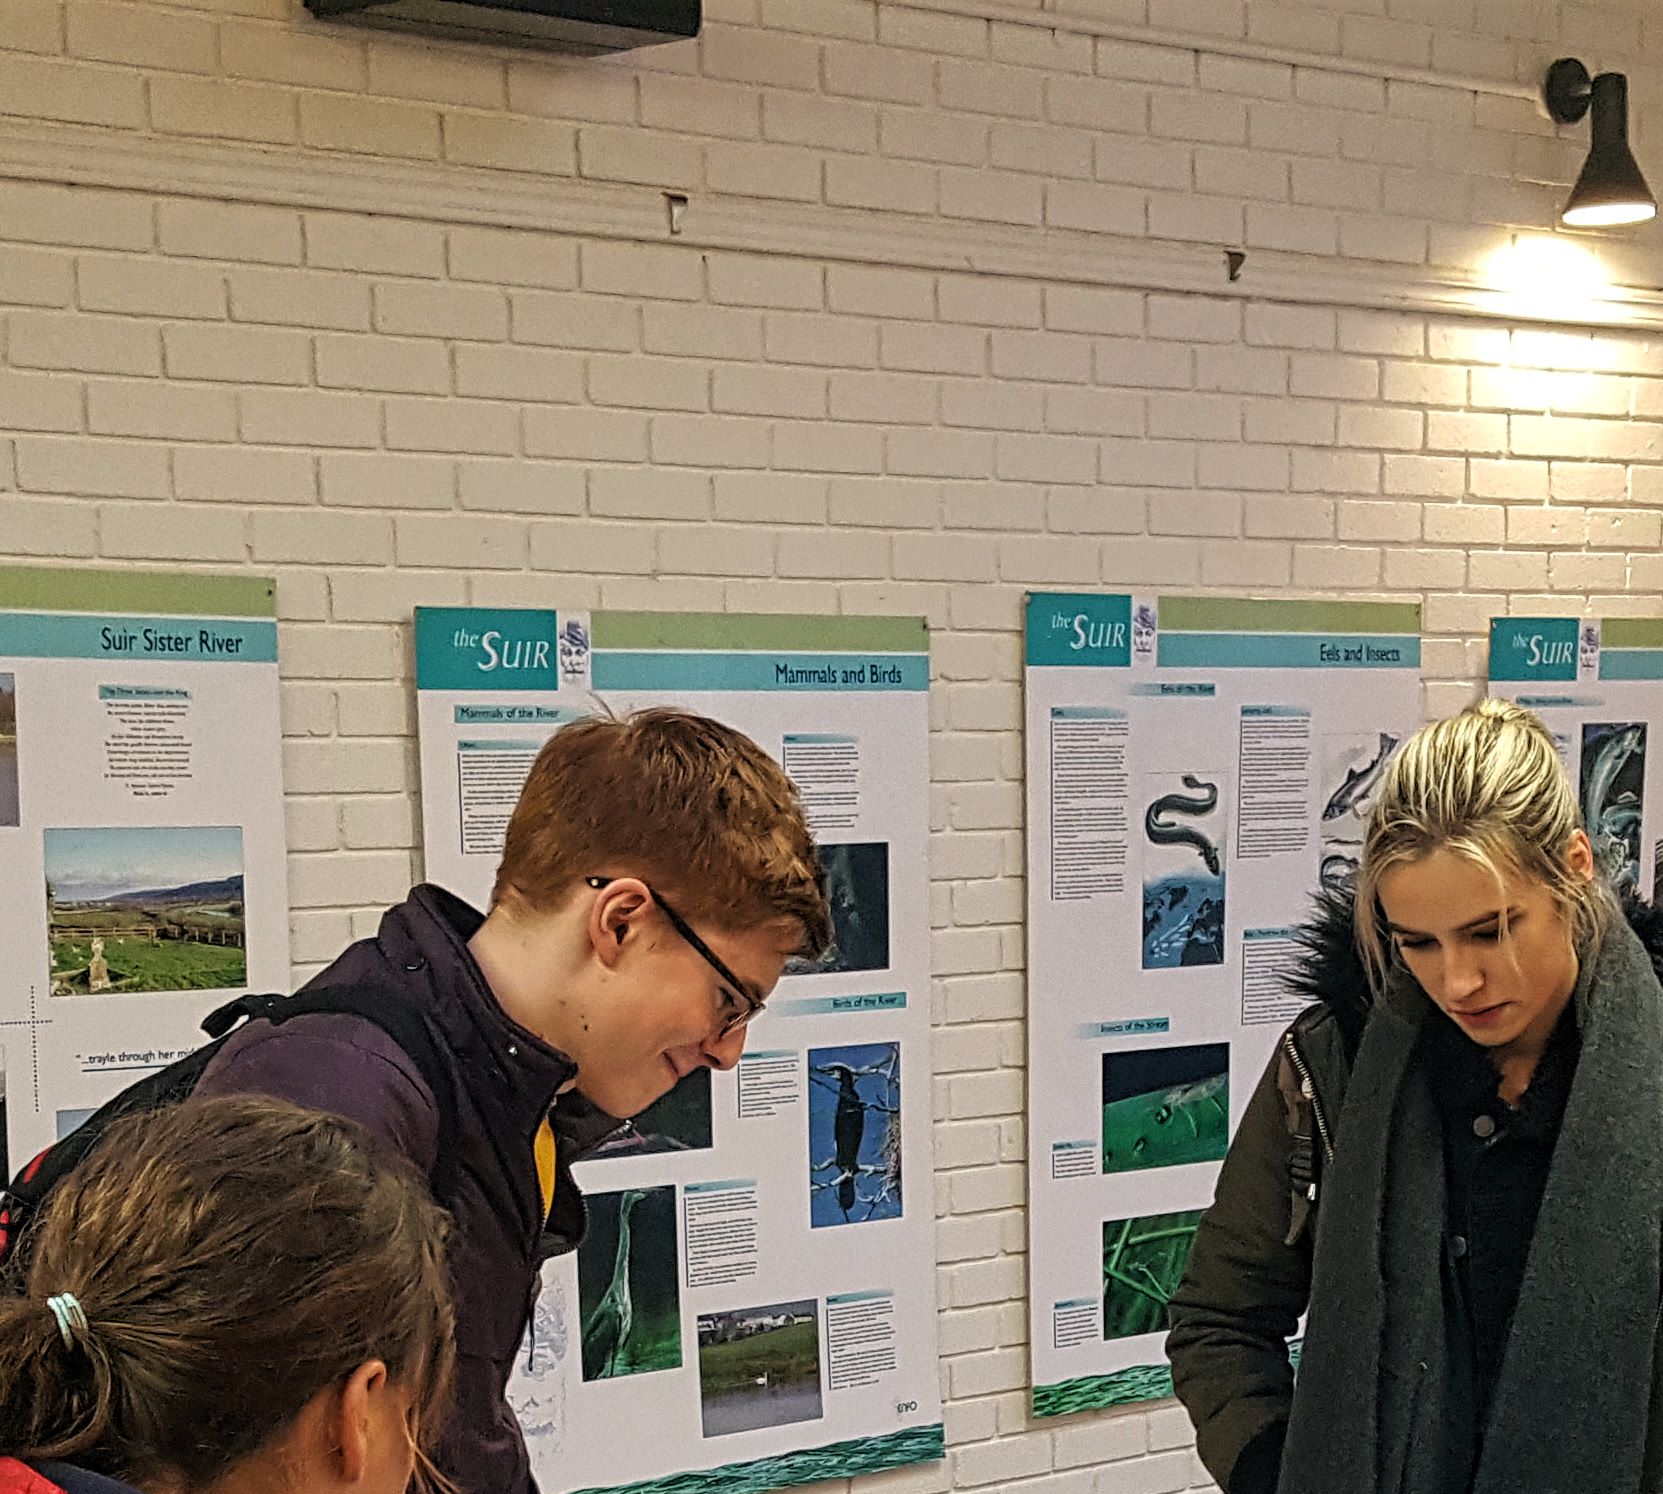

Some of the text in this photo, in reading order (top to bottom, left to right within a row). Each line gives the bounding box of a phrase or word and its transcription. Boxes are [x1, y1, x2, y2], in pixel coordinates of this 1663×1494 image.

[101, 628, 243, 654] Suir Sister River
[1051, 613, 1125, 651] the SUIR
[454, 628, 549, 672] the SUIR
[1320, 645, 1401, 662] Eels and Insects
[1512, 634, 1573, 666] the SUIR
[775, 664, 903, 684] Mammals and Birds
[461, 706, 559, 718] Mammals of the River
[118, 1052, 155, 1063] through
[158, 1050, 174, 1059] her
